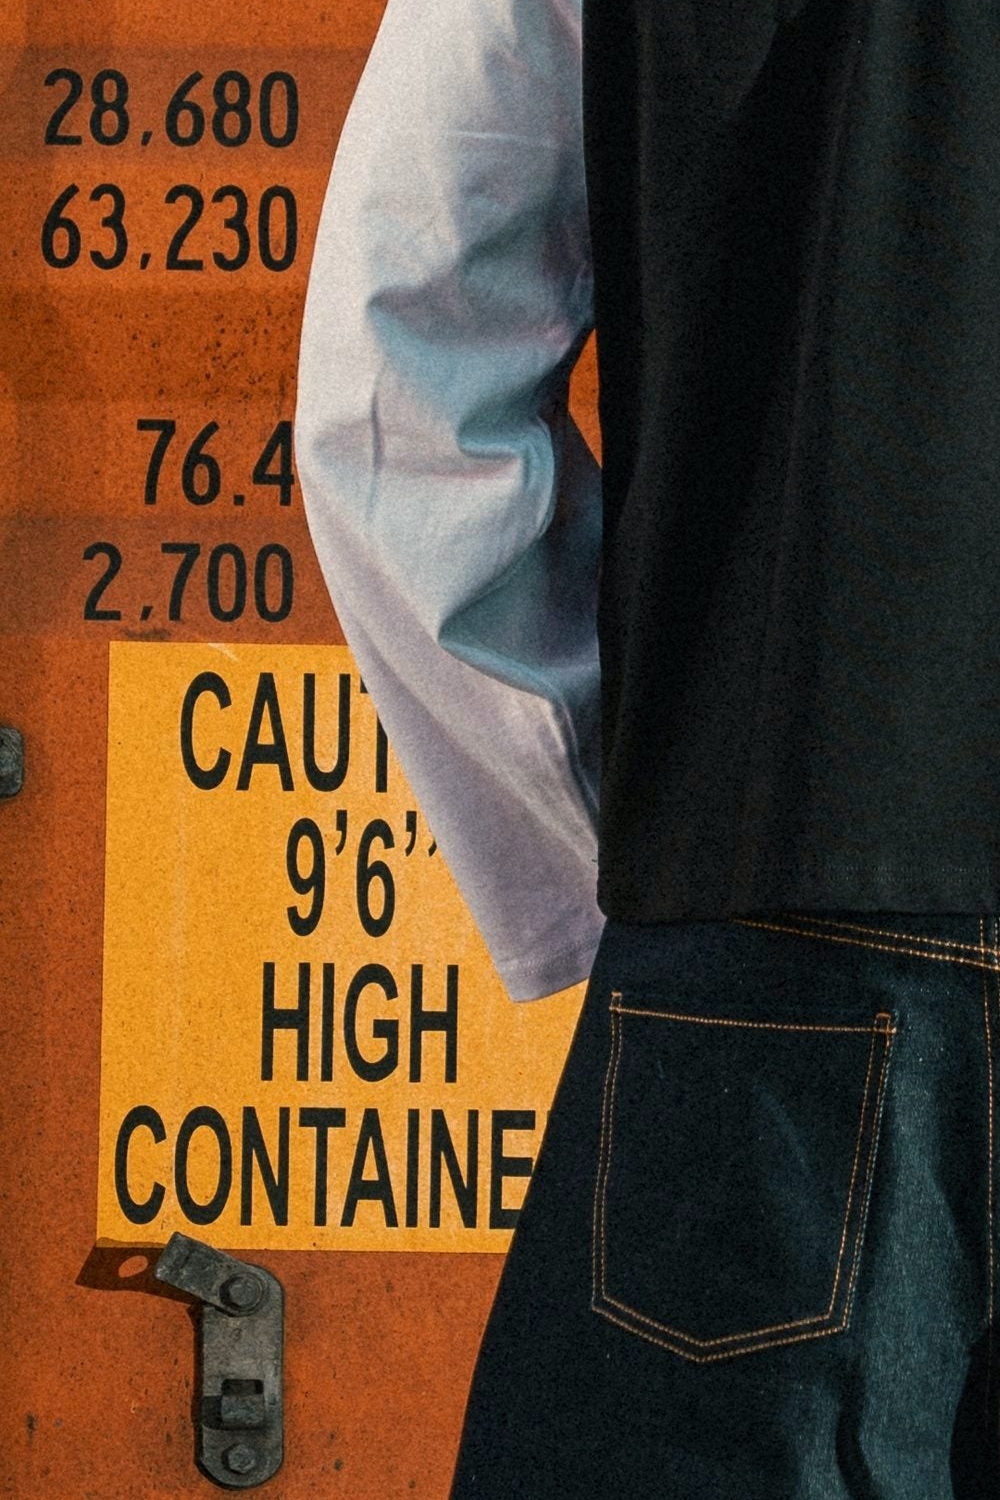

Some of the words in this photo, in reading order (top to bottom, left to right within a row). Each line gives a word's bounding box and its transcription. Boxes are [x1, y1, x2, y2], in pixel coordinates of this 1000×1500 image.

[44, 68, 299, 148] 28,680
[41, 184, 297, 271] 63,230
[83, 542, 294, 622] 2,700
[262, 963, 457, 1082] HIGH
[115, 1105, 552, 1229] CONTAINE
